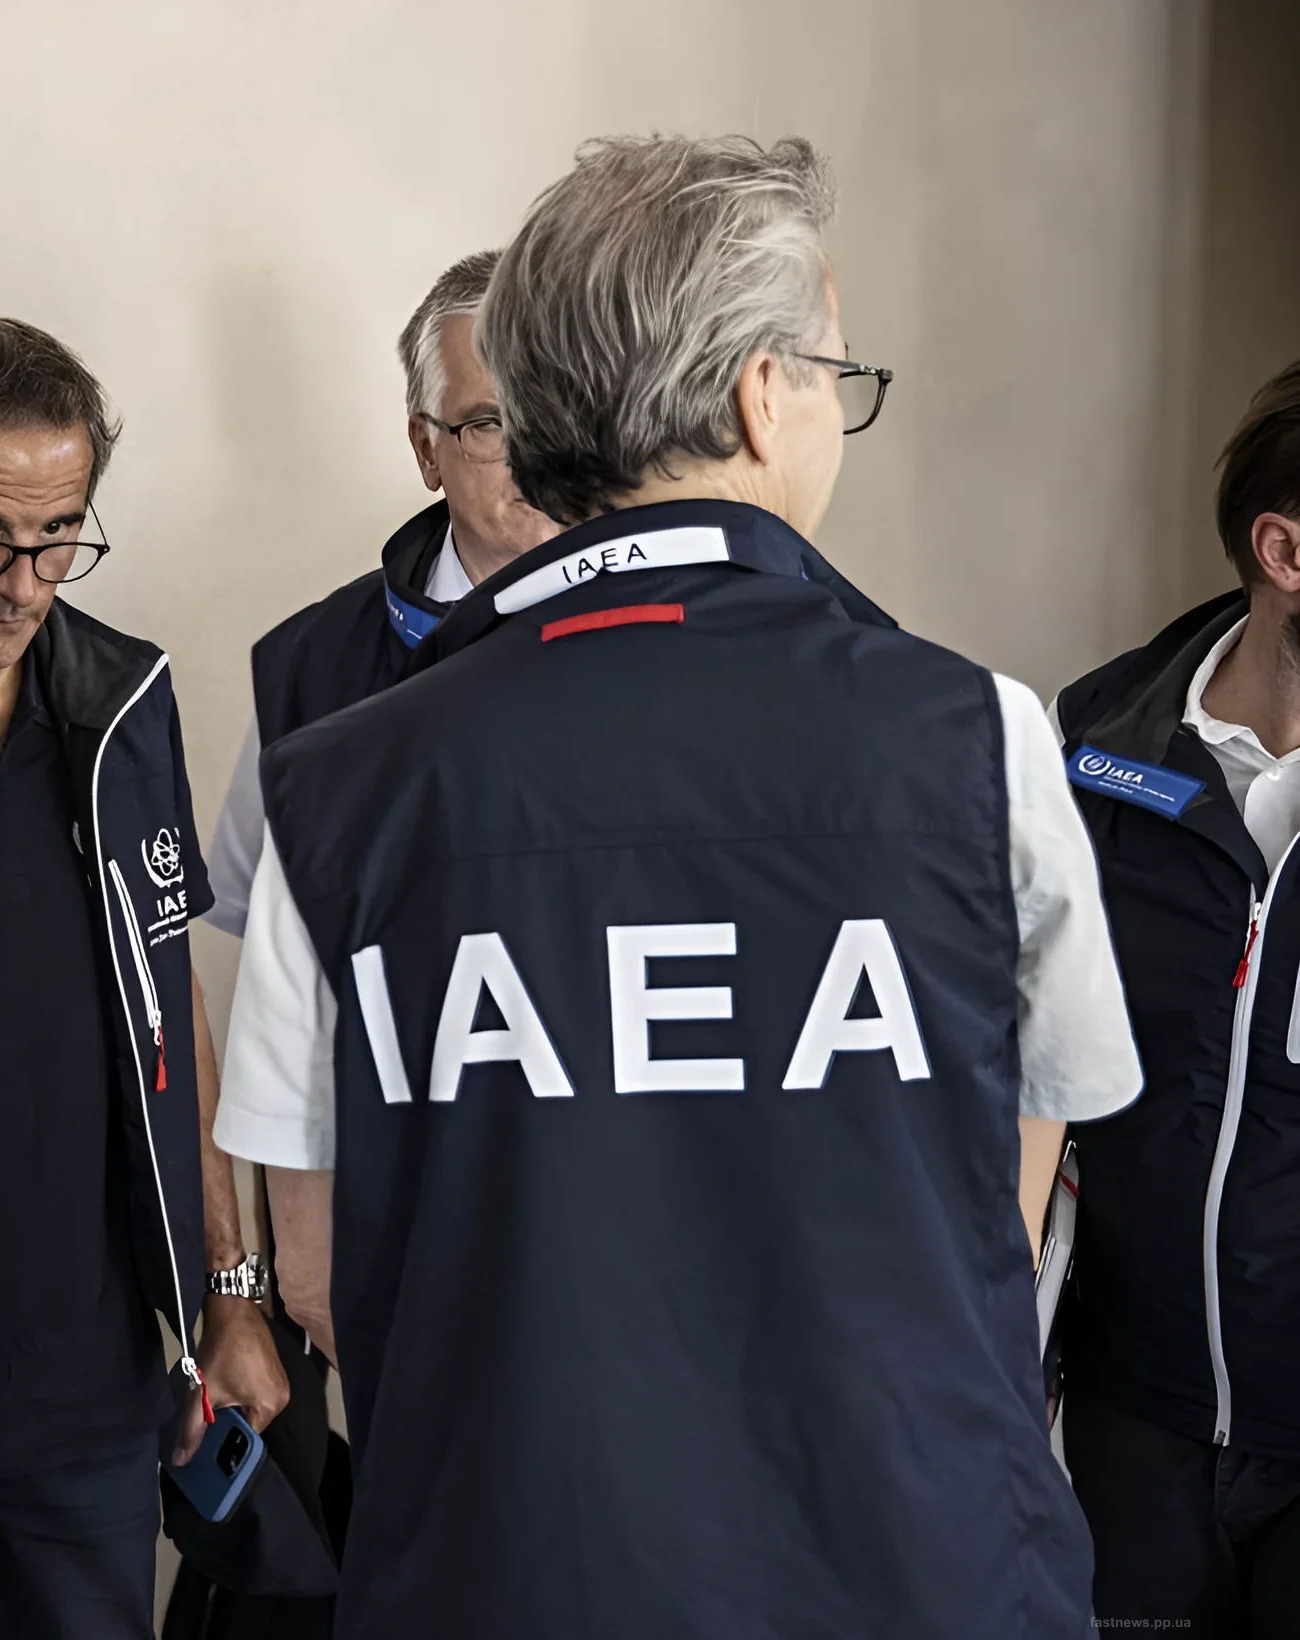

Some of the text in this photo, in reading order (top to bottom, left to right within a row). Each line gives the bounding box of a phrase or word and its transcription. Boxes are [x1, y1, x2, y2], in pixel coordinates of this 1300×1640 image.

[562, 543, 647, 584] IAEA
[1107, 766, 1143, 784] IAEA
[156, 889, 188, 918] IAE
[351, 919, 932, 1104] IAEA
